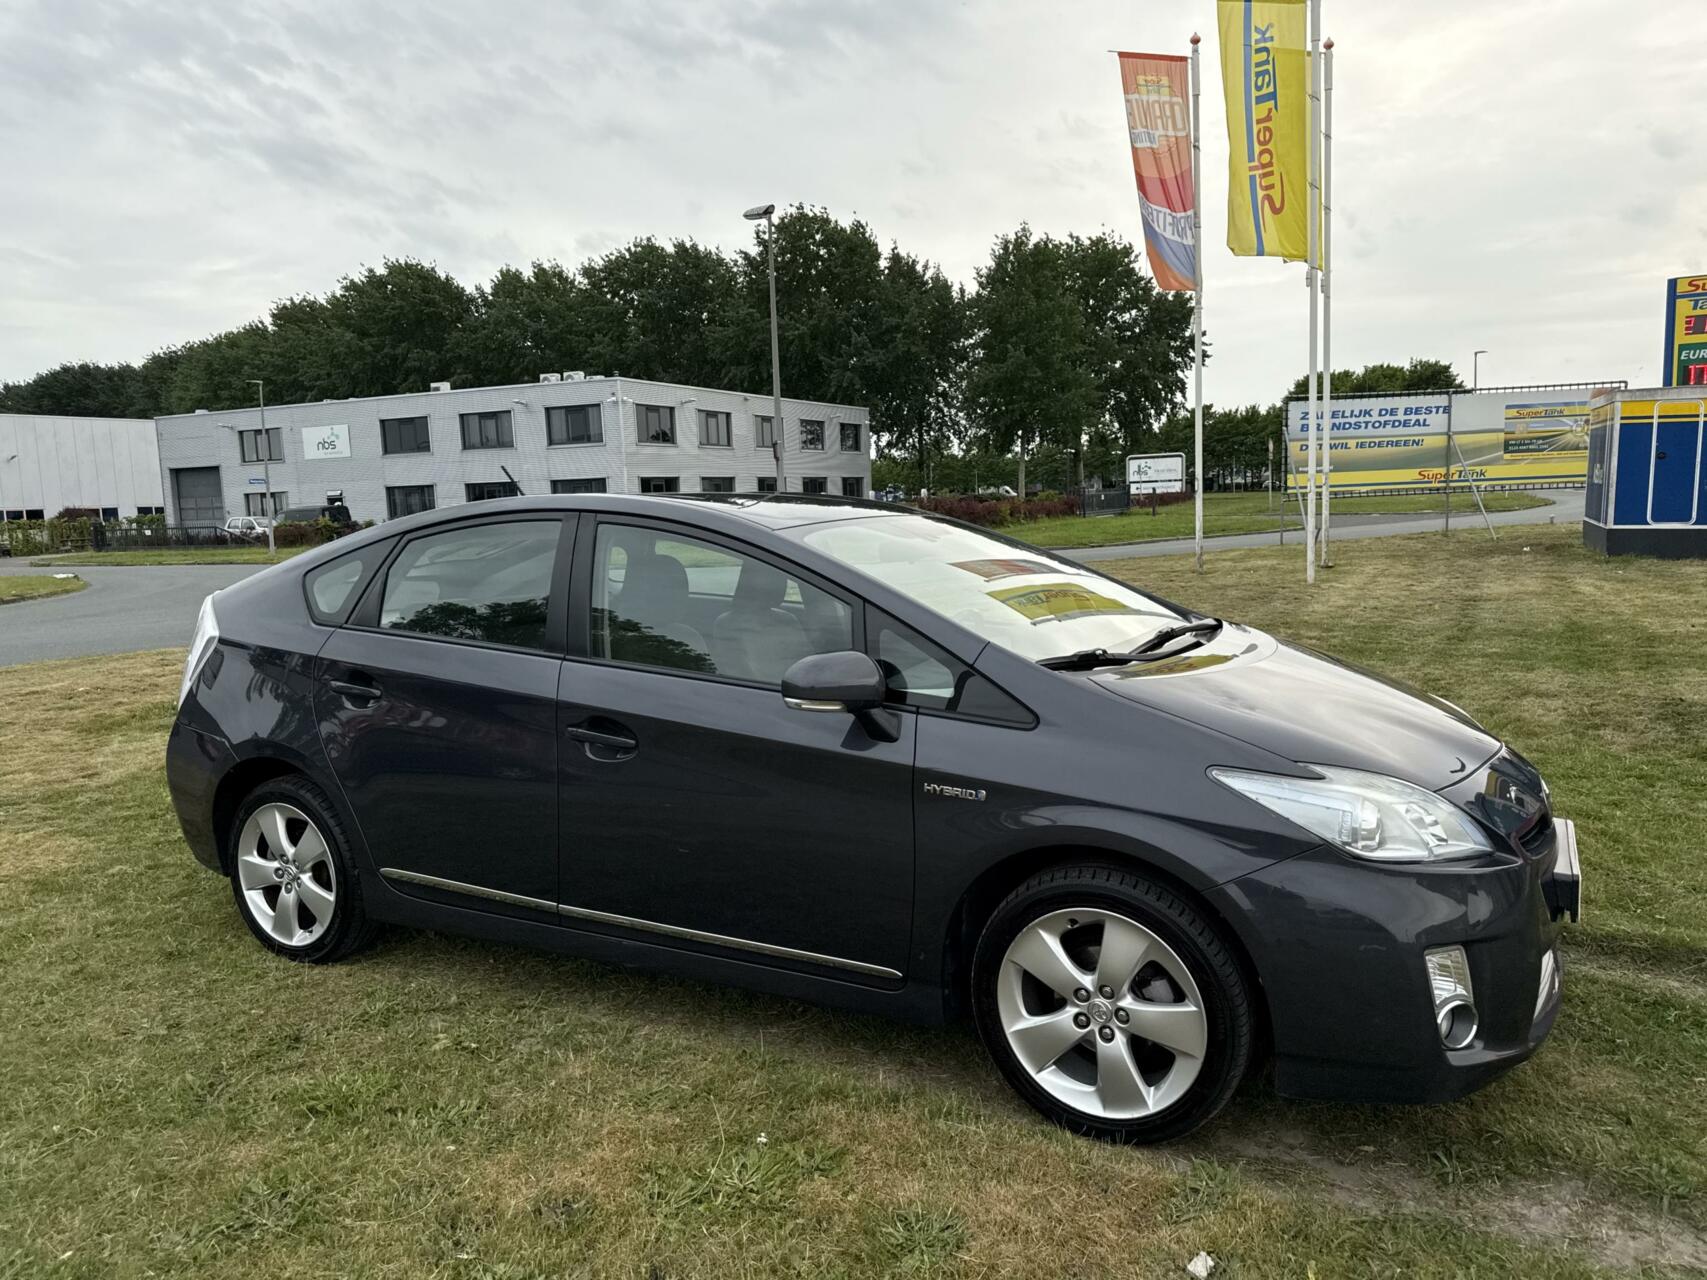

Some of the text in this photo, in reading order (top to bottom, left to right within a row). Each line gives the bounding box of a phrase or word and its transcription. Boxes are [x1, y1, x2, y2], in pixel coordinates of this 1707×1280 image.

[1300, 405, 1451, 420] ZELIJK DE BESTE
[1300, 418, 1430, 432] BNDSTOFDEAL
[317, 437, 336, 451] nbs
[1300, 439, 1424, 451] DT WIL IEDEREEN!
[924, 782, 976, 800] HYBRID
